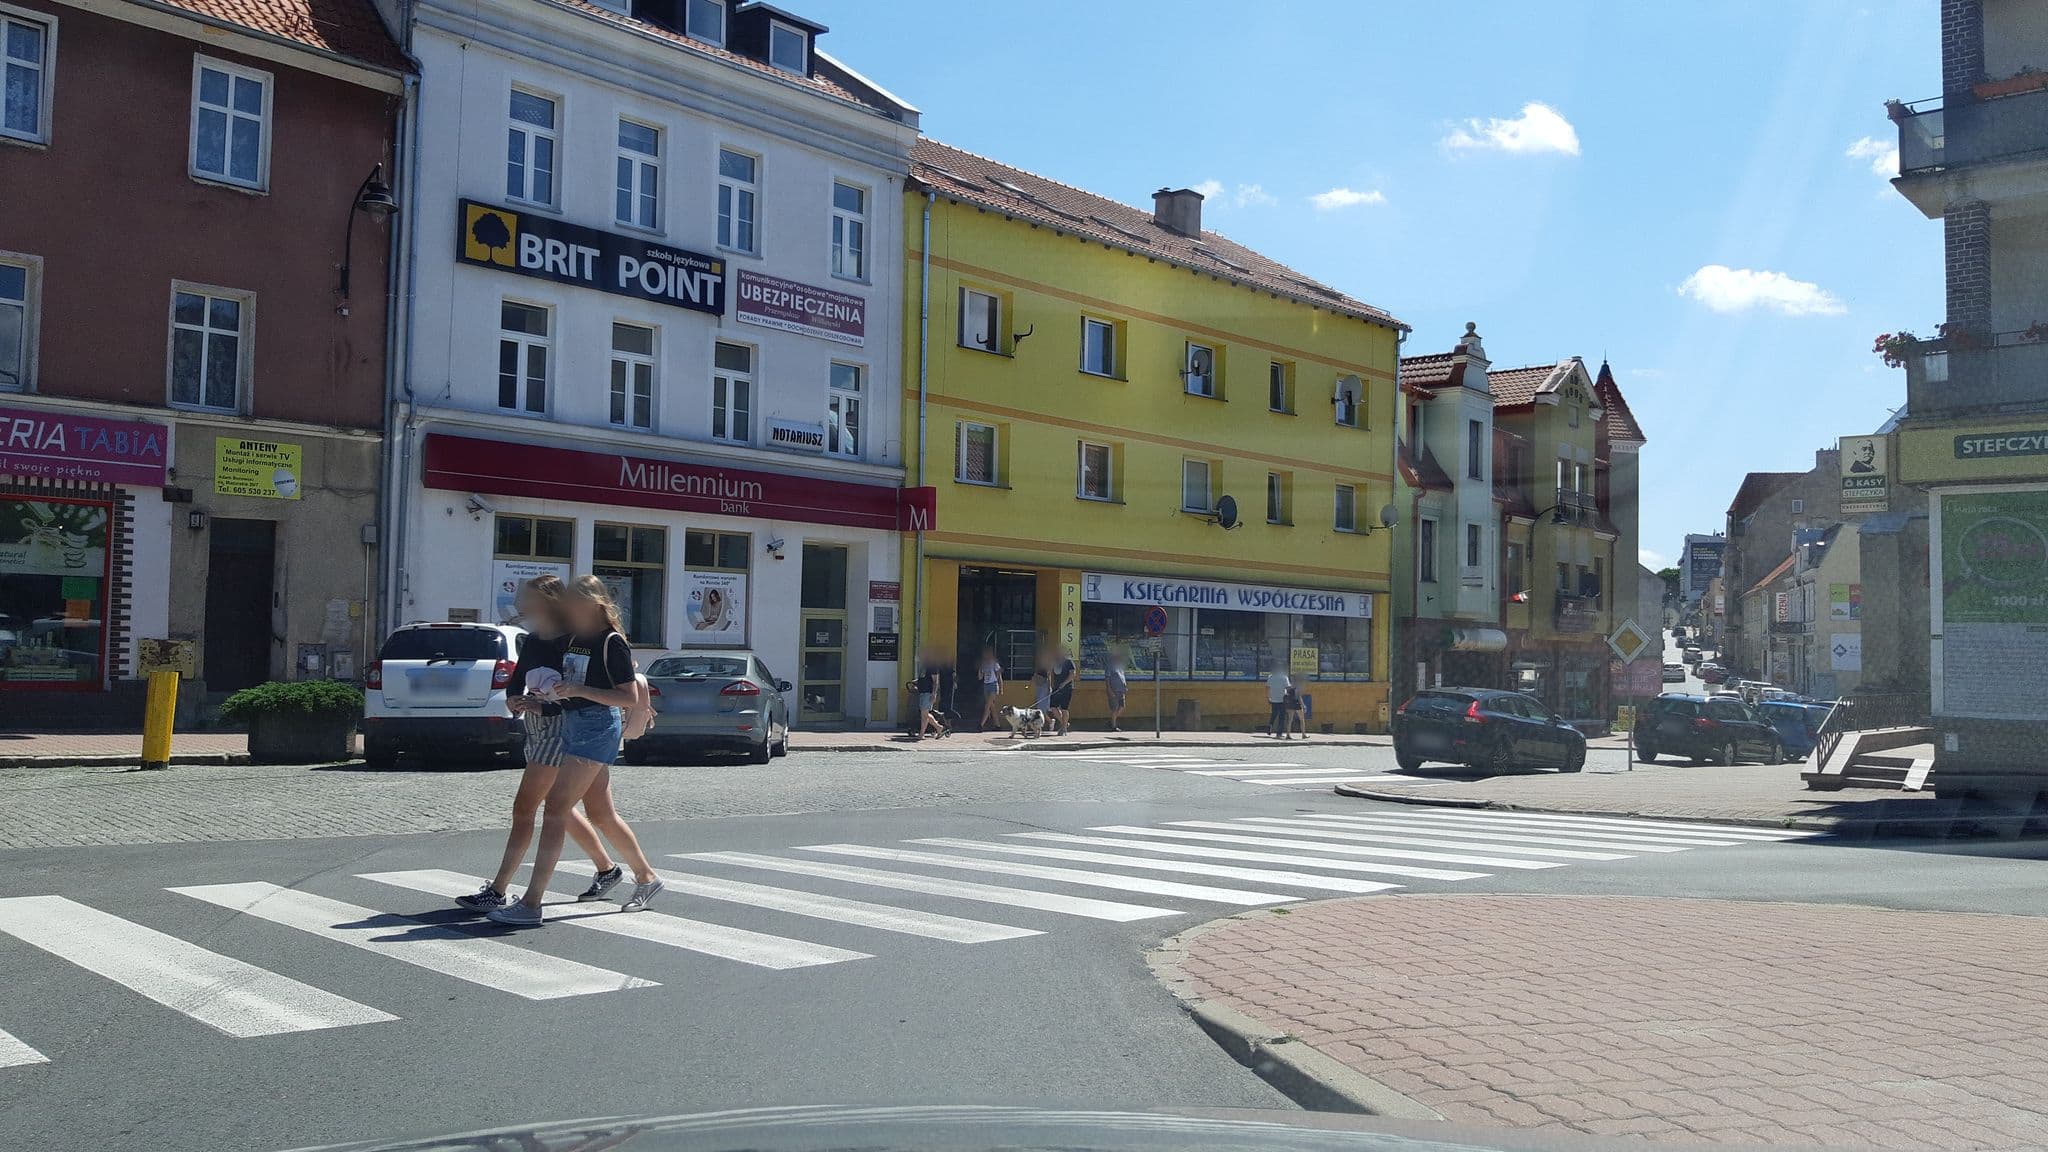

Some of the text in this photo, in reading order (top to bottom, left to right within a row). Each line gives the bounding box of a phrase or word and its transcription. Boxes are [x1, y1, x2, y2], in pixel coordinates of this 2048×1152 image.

[647, 249, 710, 270] szkoła językowa
[520, 232, 721, 306] BRIT POINT
[741, 282, 862, 324] UBEZPIECZENIA
[772, 427, 823, 446] NOTARIUSZ
[226, 448, 250, 456] Montaż
[240, 441, 278, 452] ANTENY
[222, 456, 244, 465] Usługi
[14, 462, 50, 475] swoje
[57, 465, 100, 477] piękno
[222, 466, 260, 476] Monitoring
[619, 456, 762, 500] Millennium
[1856, 478, 1883, 487] KASY
[720, 500, 750, 514] bank
[908, 504, 928, 530] M
[1123, 582, 1345, 612] KSIĘGARNIA WSPÓŁCZESNA
